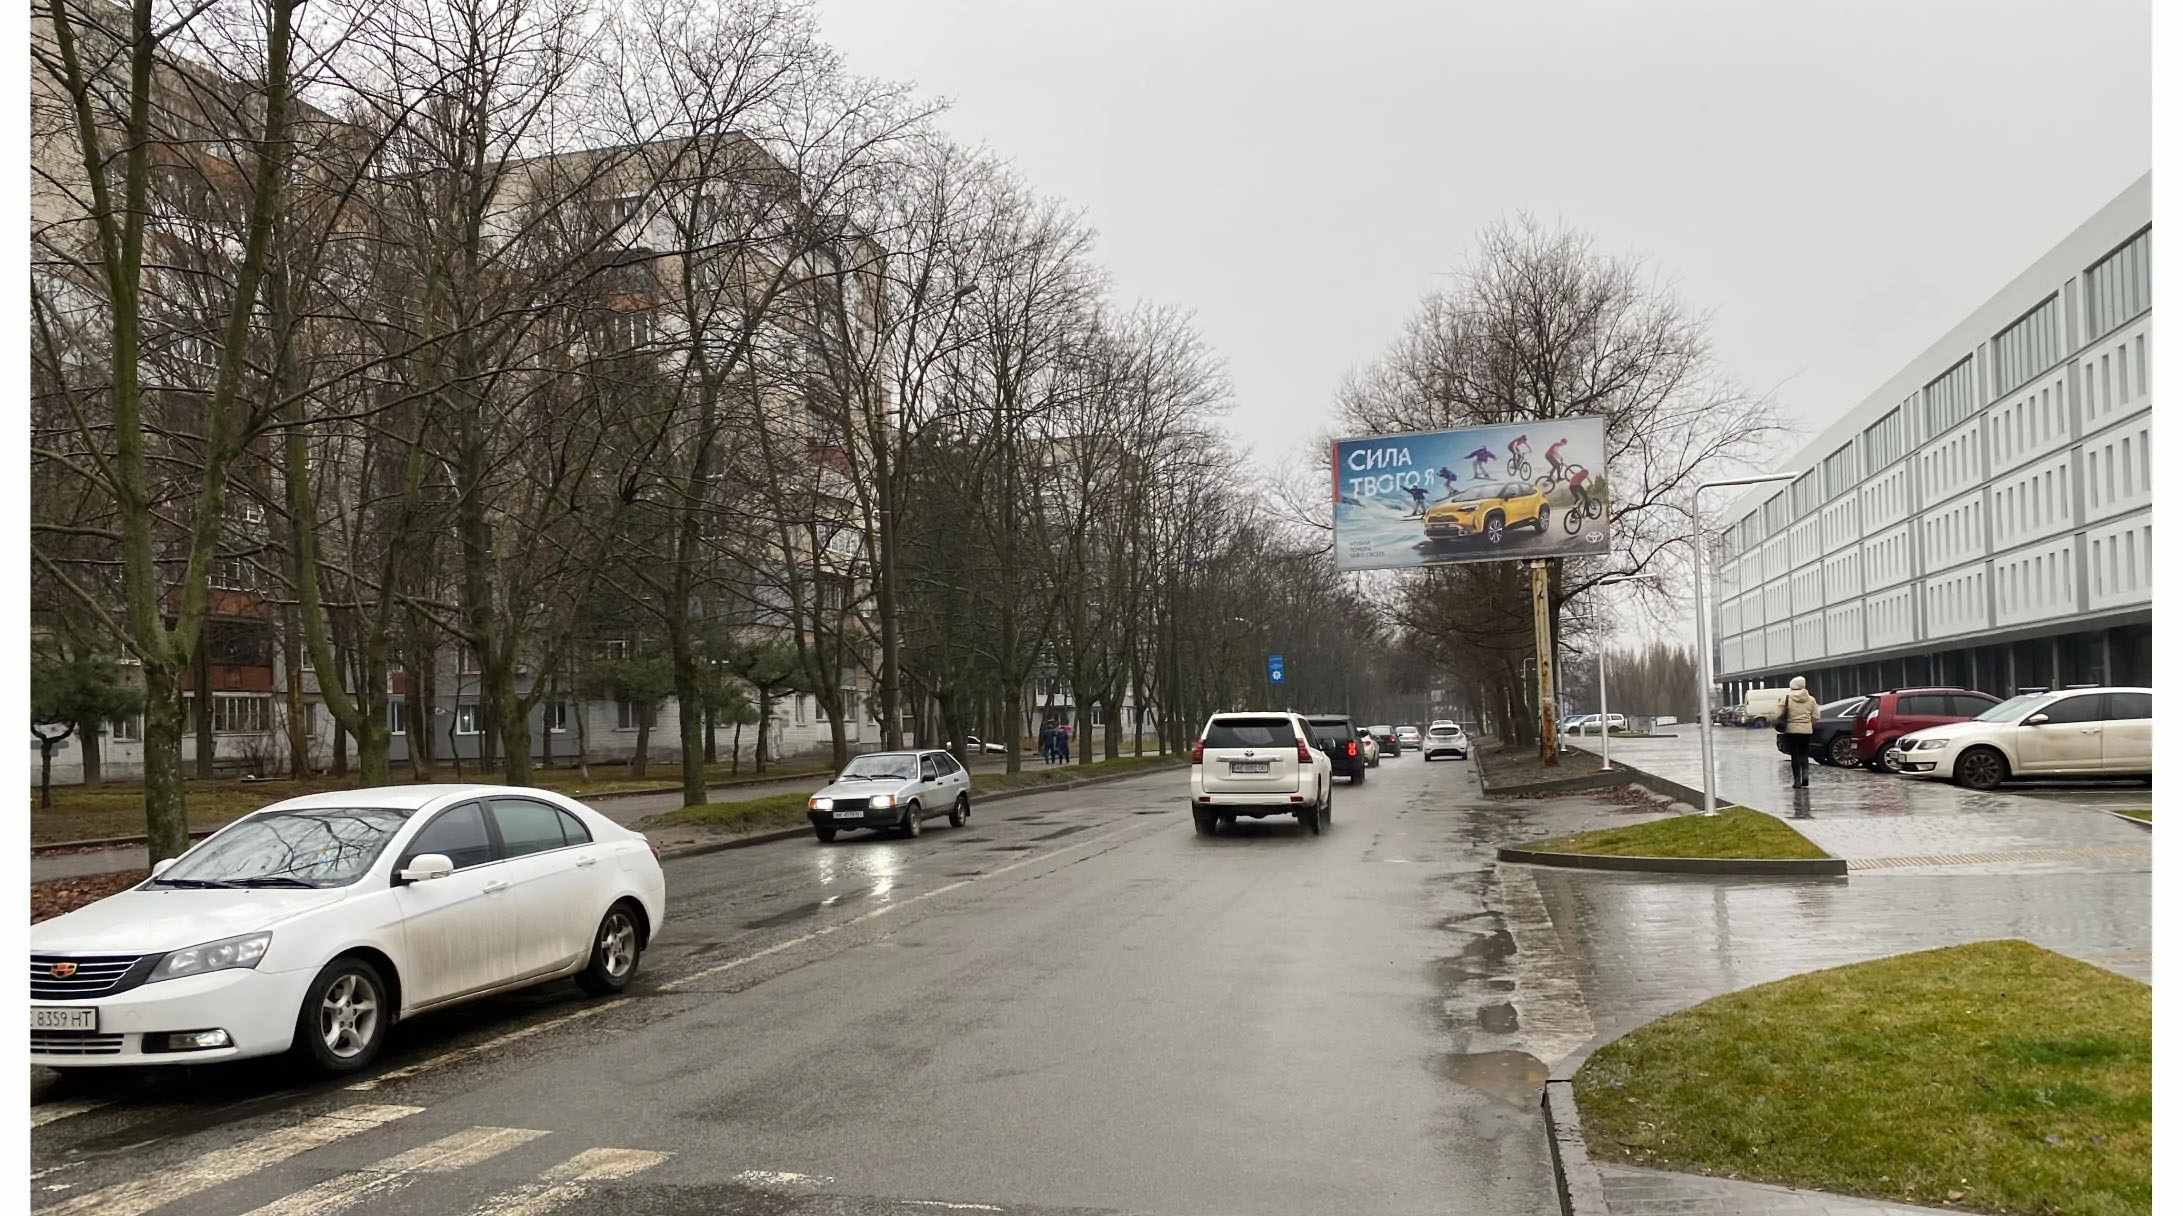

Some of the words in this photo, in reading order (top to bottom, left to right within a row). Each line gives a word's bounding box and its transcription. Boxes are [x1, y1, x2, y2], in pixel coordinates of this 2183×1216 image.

[1348, 447, 1412, 471] СИЛА
[1349, 470, 1420, 499] ТВОГО
[1424, 468, 1435, 486] Я
[37, 1011, 67, 1026] 8359
[71, 1011, 91, 1027] HT
